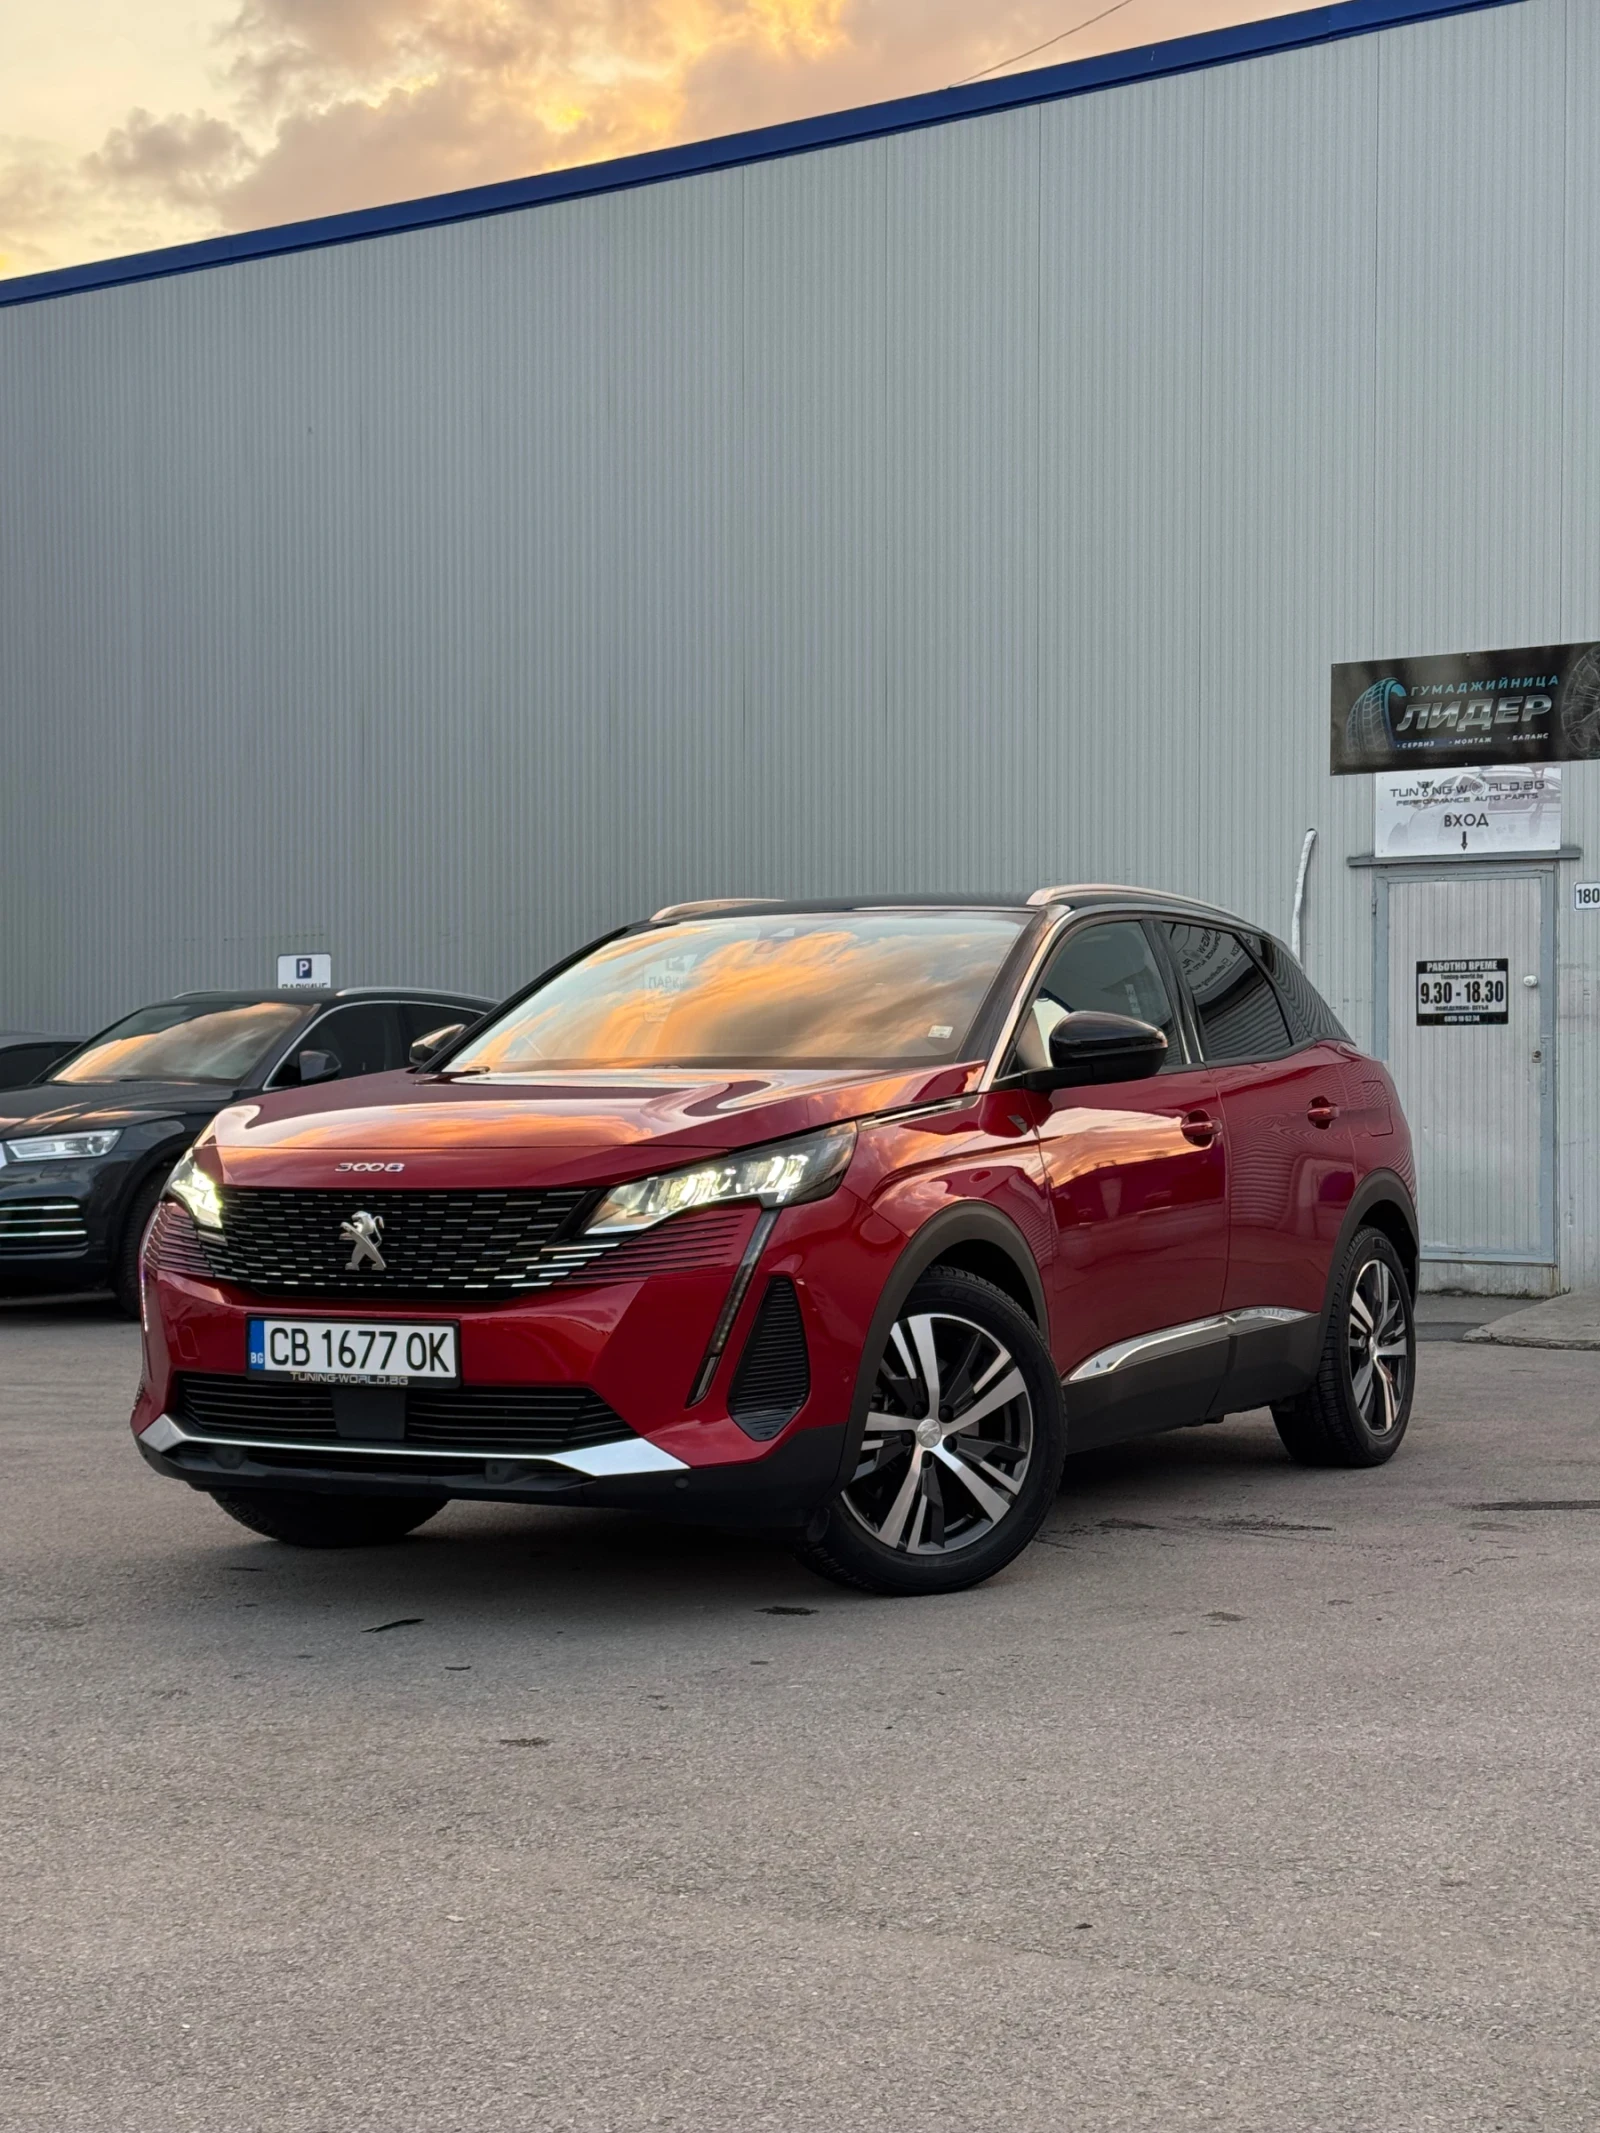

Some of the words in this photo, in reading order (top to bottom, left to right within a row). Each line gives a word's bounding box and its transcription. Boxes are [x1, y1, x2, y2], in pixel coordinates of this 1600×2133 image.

[1410, 675, 1559, 697] ГУМАДЖИЙНИЦА
[1396, 694, 1552, 732] ЛИДЕР
[1454, 736, 1492, 745] МОНТАЖ
[1512, 732, 1549, 741] БАЛАНС
[1396, 796, 1471, 806] PERFORMANCE
[1474, 794, 1501, 803] AUTO
[1505, 792, 1539, 801] PARTS
[1444, 812, 1489, 828] ВХОД
[1576, 887, 1600, 904] 180
[1426, 961, 1467, 972] РАБОТНО
[1468, 960, 1498, 971] ВРЕМЕ
[1420, 981, 1452, 1004] 9.30
[1464, 980, 1504, 1003] 18.30
[334, 1162, 405, 1172] 3008
[269, 1327, 311, 1367] CB
[321, 1328, 398, 1370] 1677
[405, 1332, 450, 1373] OK
[250, 1352, 264, 1364] BG
[290, 1371, 409, 1386] TUNING-WORLD.BG
